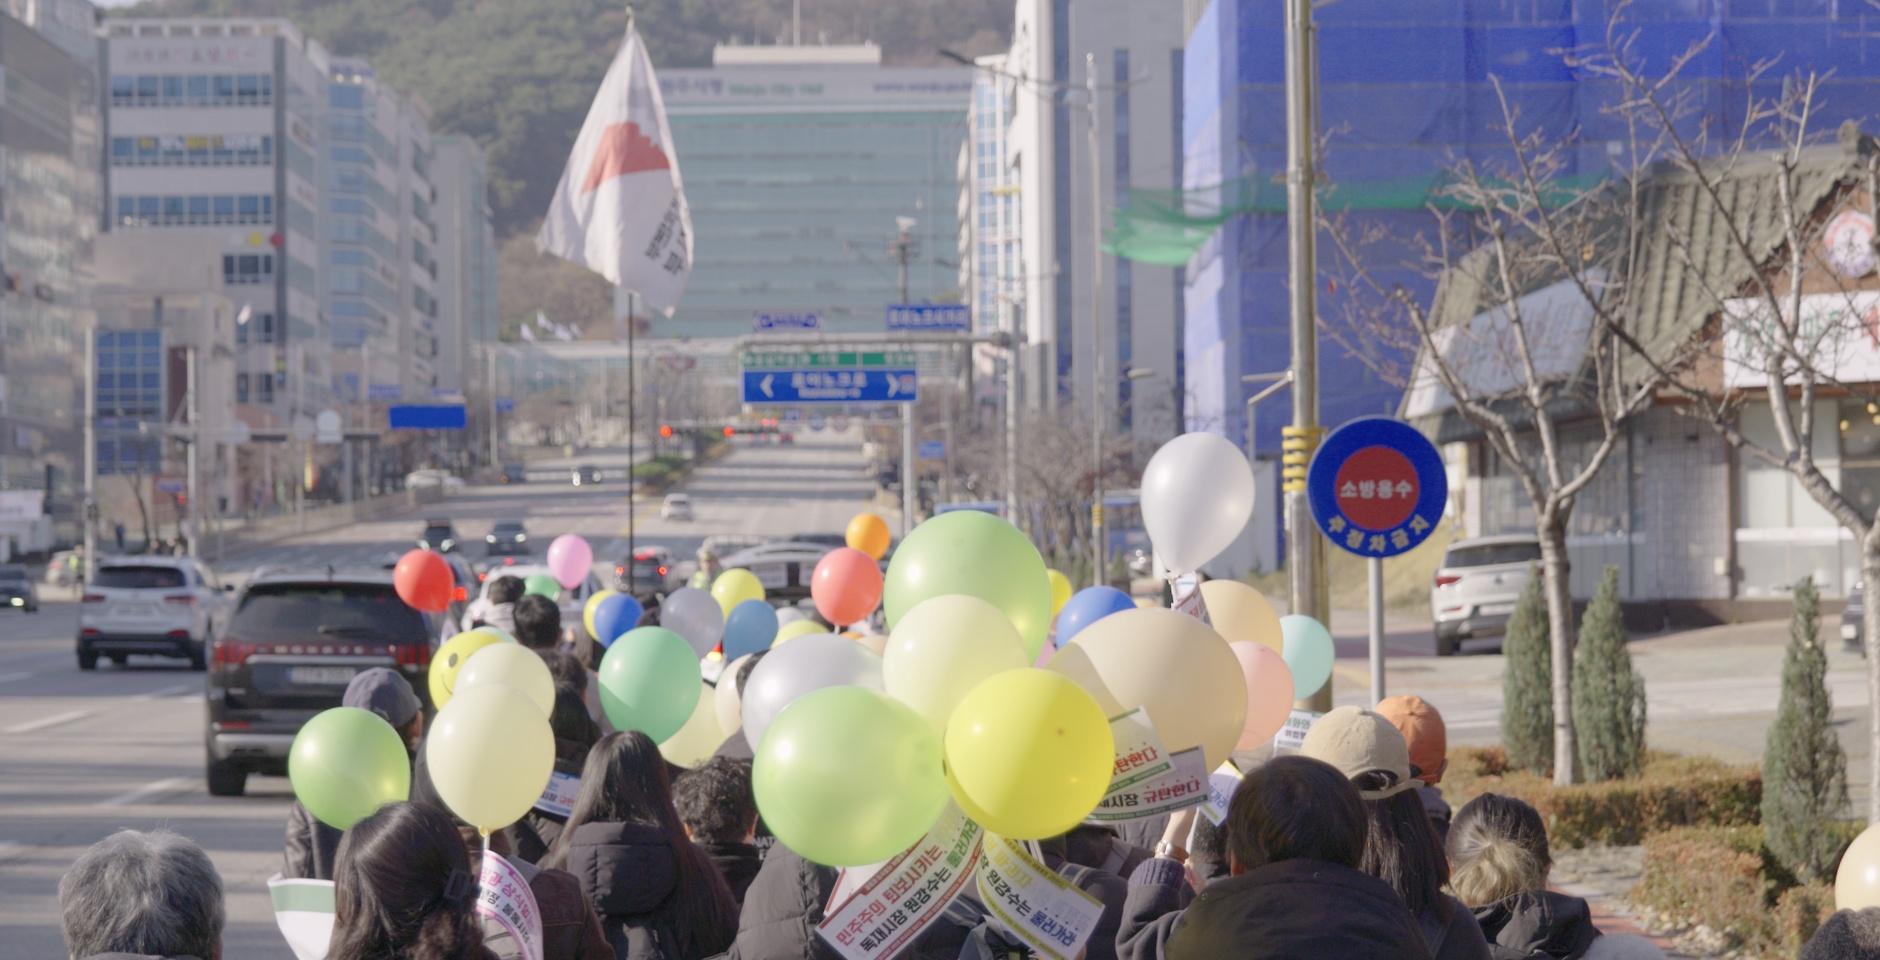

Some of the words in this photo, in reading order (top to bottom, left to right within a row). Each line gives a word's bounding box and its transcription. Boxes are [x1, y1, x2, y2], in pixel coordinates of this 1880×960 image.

[1340, 479, 1413, 499] 소방용수
[1327, 513, 1430, 553] 주정차금지
[1143, 778, 1201, 803] 규탄한다
[834, 899, 888, 946] 민주주의
[881, 844, 943, 905] 퇴보시키는
[859, 909, 909, 952] 독재시장
[903, 866, 952, 914] 원강수는
[986, 868, 1032, 917] 원강수는
[1029, 910, 1078, 948] 물러가라
